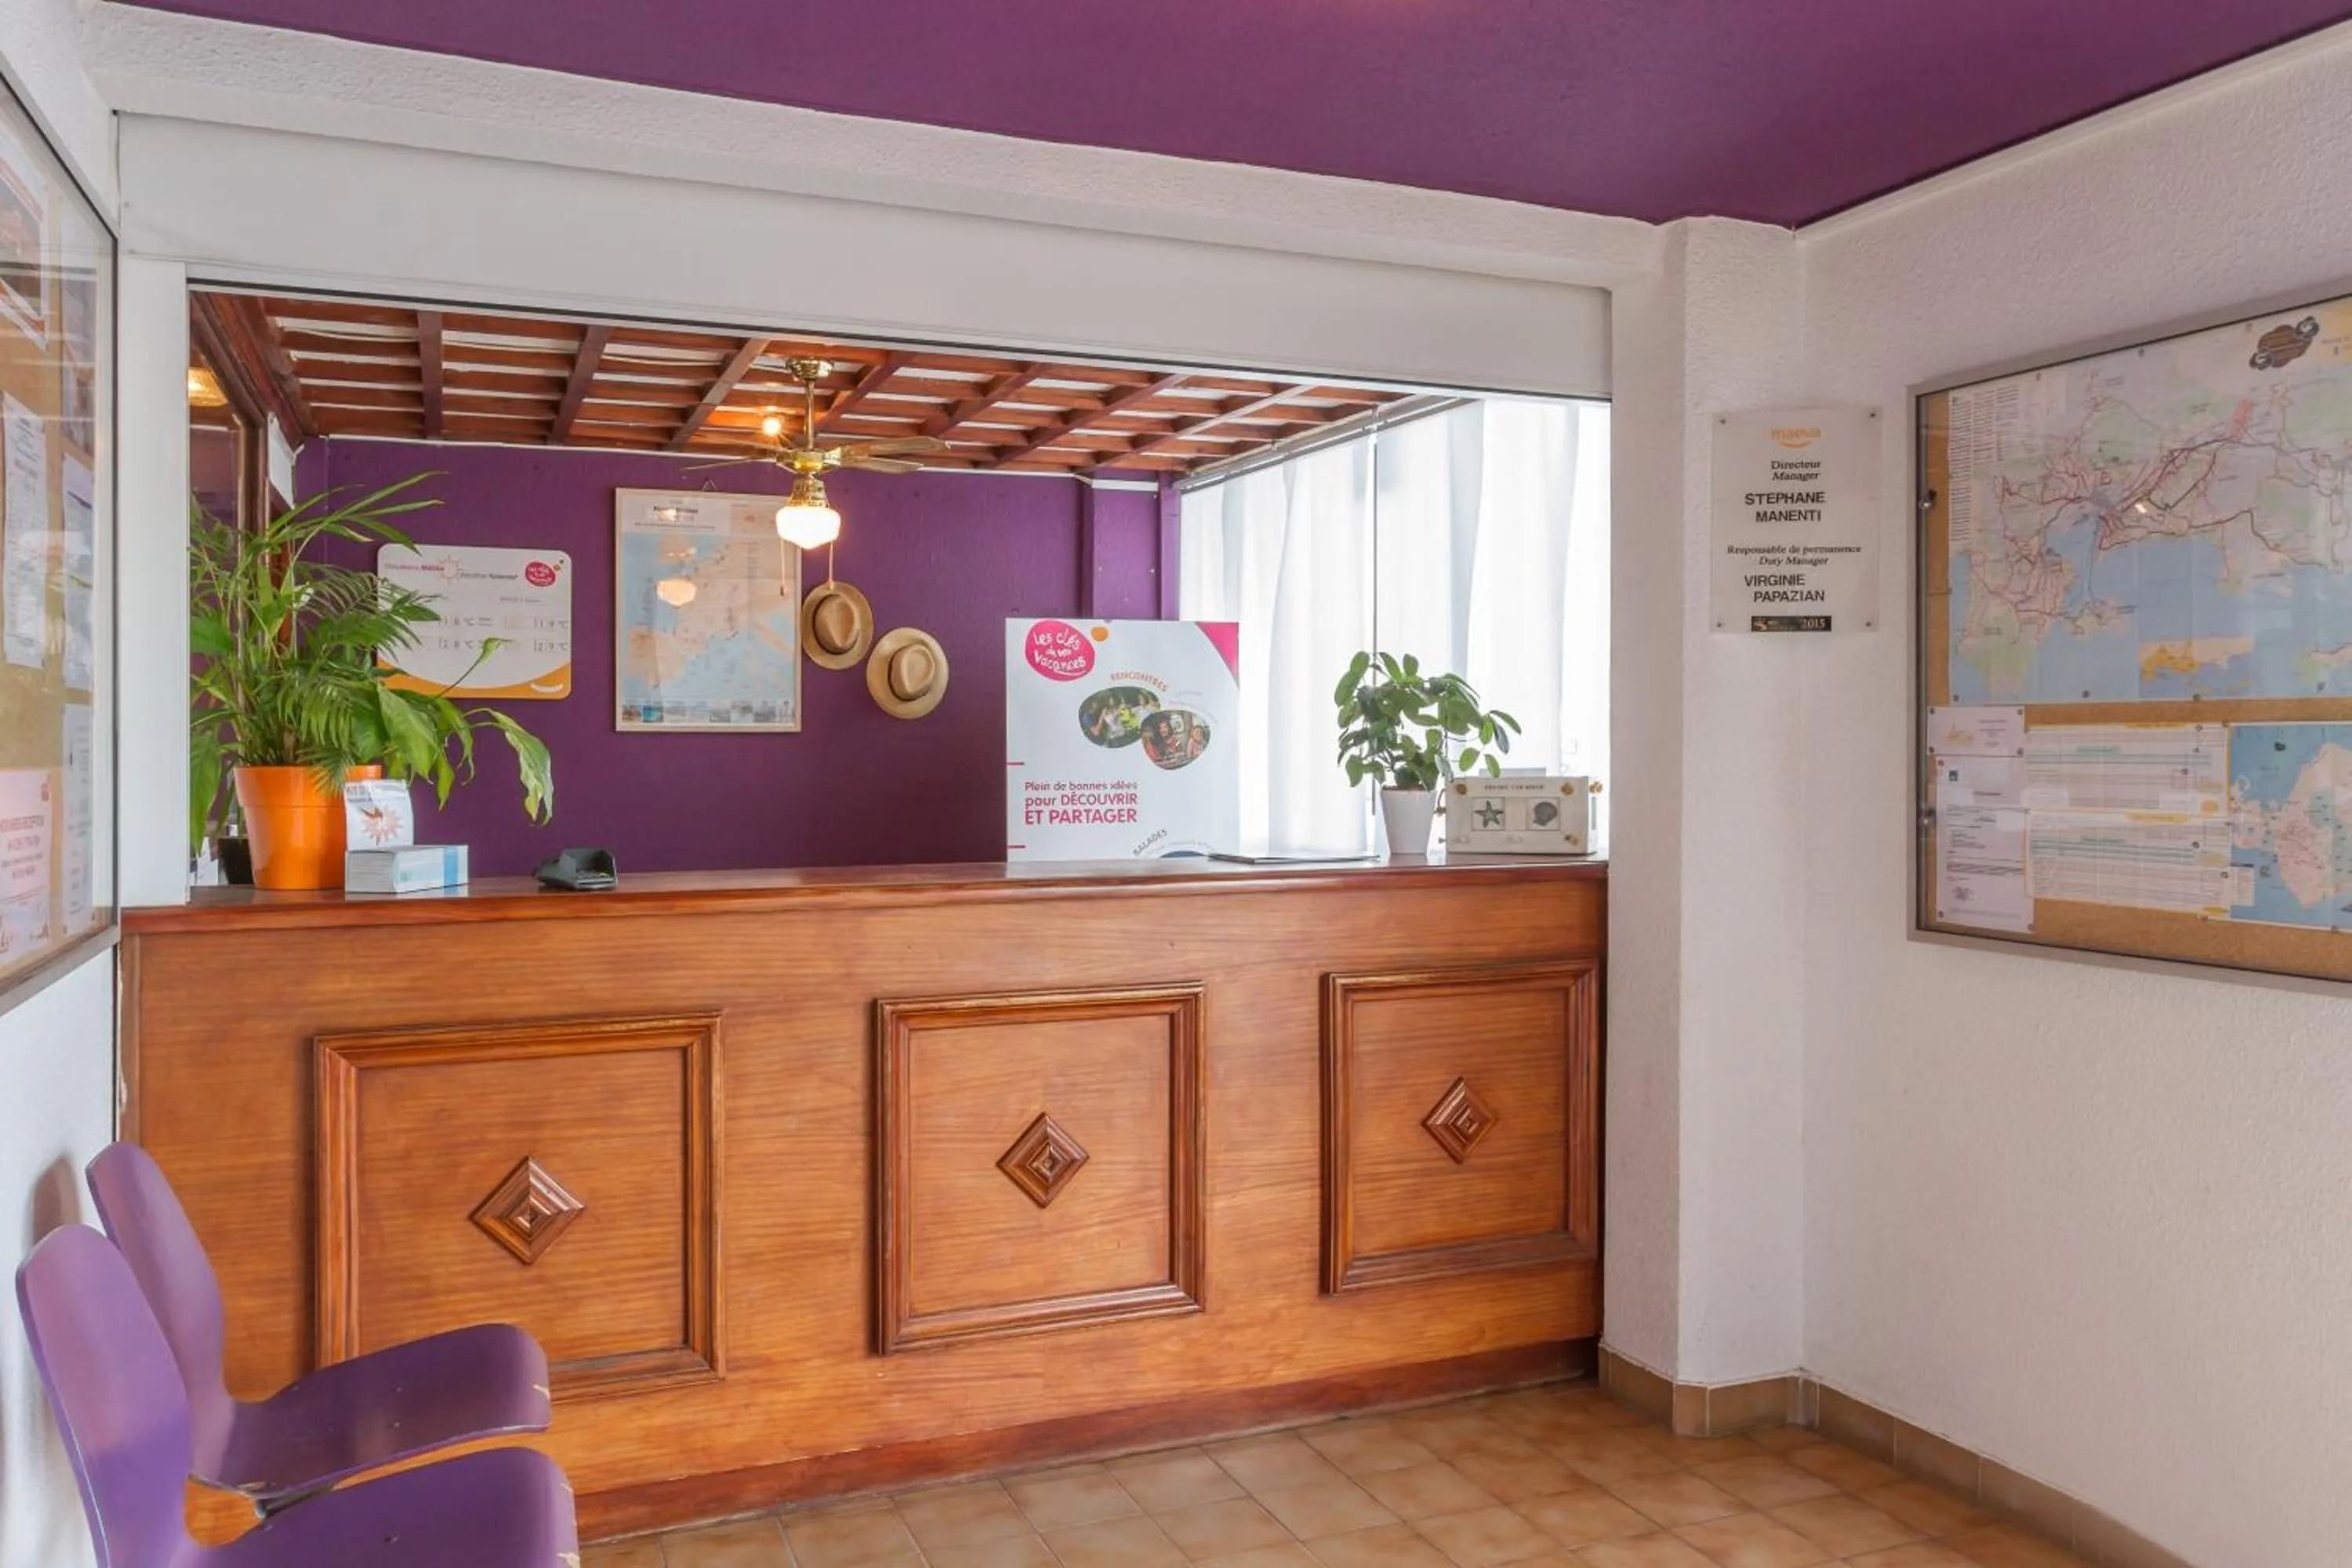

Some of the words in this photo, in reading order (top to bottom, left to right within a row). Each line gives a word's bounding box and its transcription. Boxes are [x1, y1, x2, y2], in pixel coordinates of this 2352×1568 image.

[1771, 460, 1821, 470] Directeur
[1772, 471, 1820, 481] Manager
[1744, 492, 1826, 505] STEPHANE
[1755, 510, 1821, 522] MANENTI
[1786, 556, 1829, 566] Manager
[1744, 574, 1806, 587] VIRGINIE
[1754, 590, 1825, 602] PAPAZIAN
[1110, 670, 1169, 692] RENCONTRES
[1025, 781, 1051, 791] Plein
[1053, 781, 1066, 791] de
[1069, 781, 1108, 791] bonnes
[1025, 797, 1057, 809] pour
[1061, 791, 1138, 806] DÉCOUVRIR
[1025, 809, 1044, 824] ET
[1048, 808, 1138, 824] PARTAGER
[1133, 829, 1167, 855] BALADES
